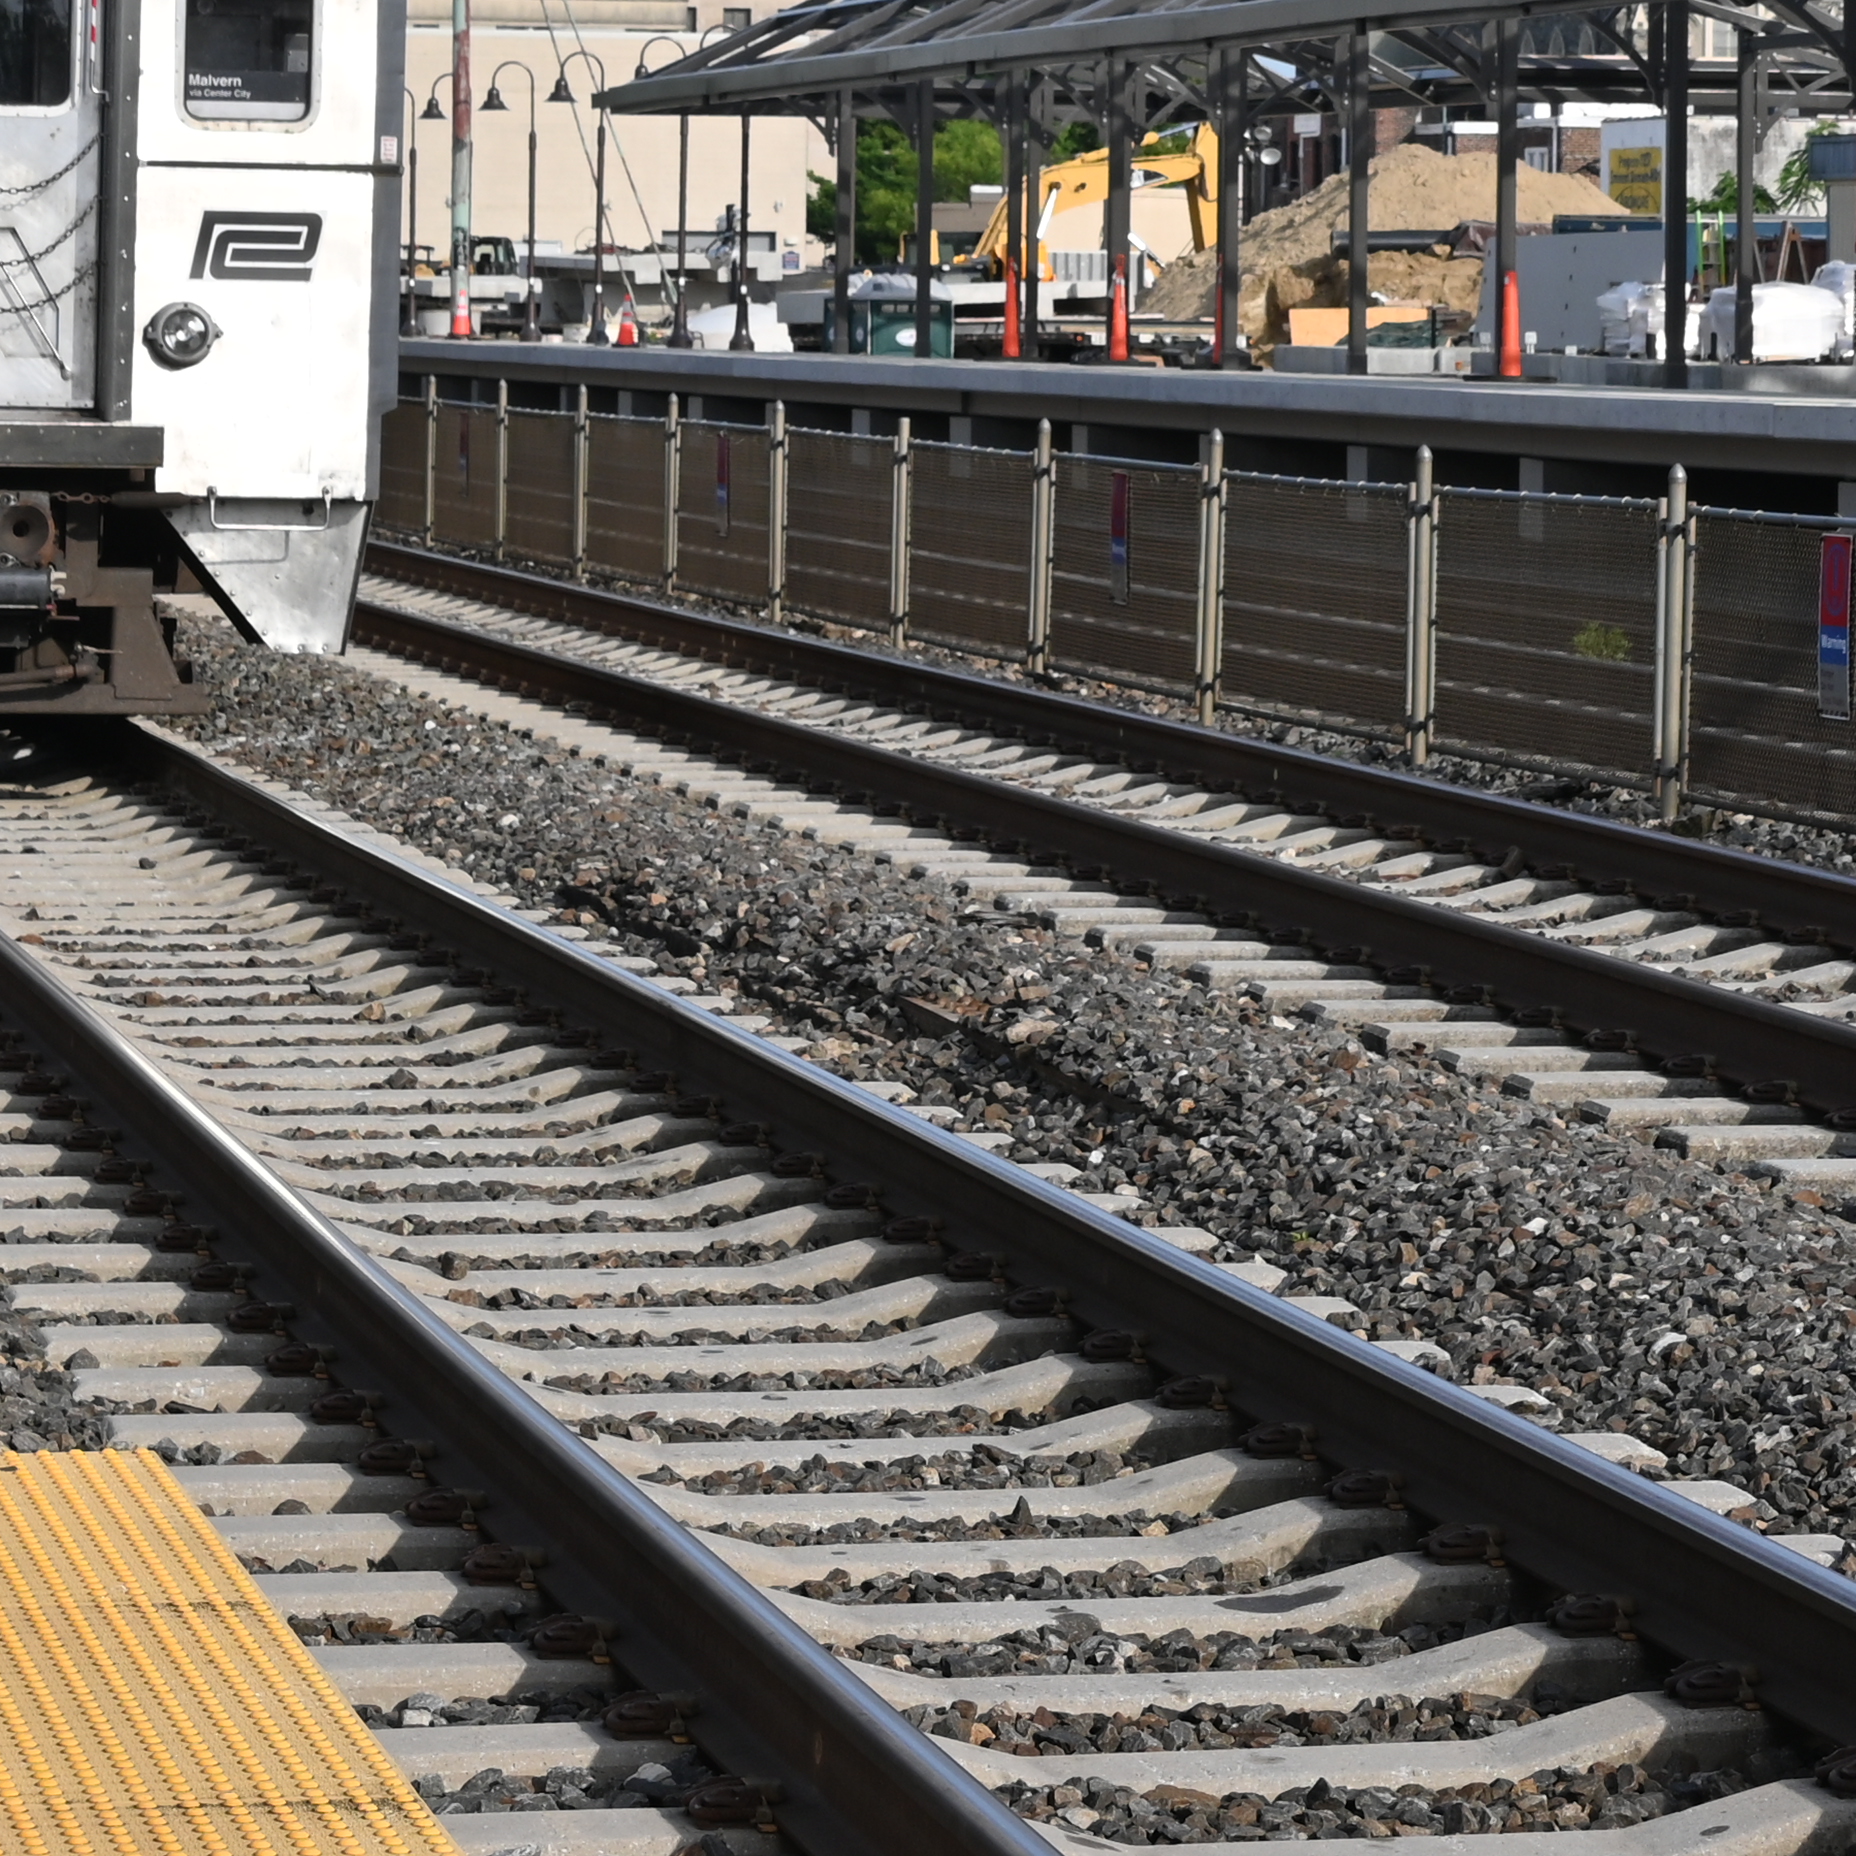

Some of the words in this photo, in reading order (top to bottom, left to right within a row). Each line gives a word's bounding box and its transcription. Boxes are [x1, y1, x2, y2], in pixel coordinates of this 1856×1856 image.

[188, 73, 242, 87] Malvern
[189, 89, 202, 97] via
[204, 88, 232, 98] Center
[234, 89, 251, 99] City
[1821, 634, 1846, 654] Warning
